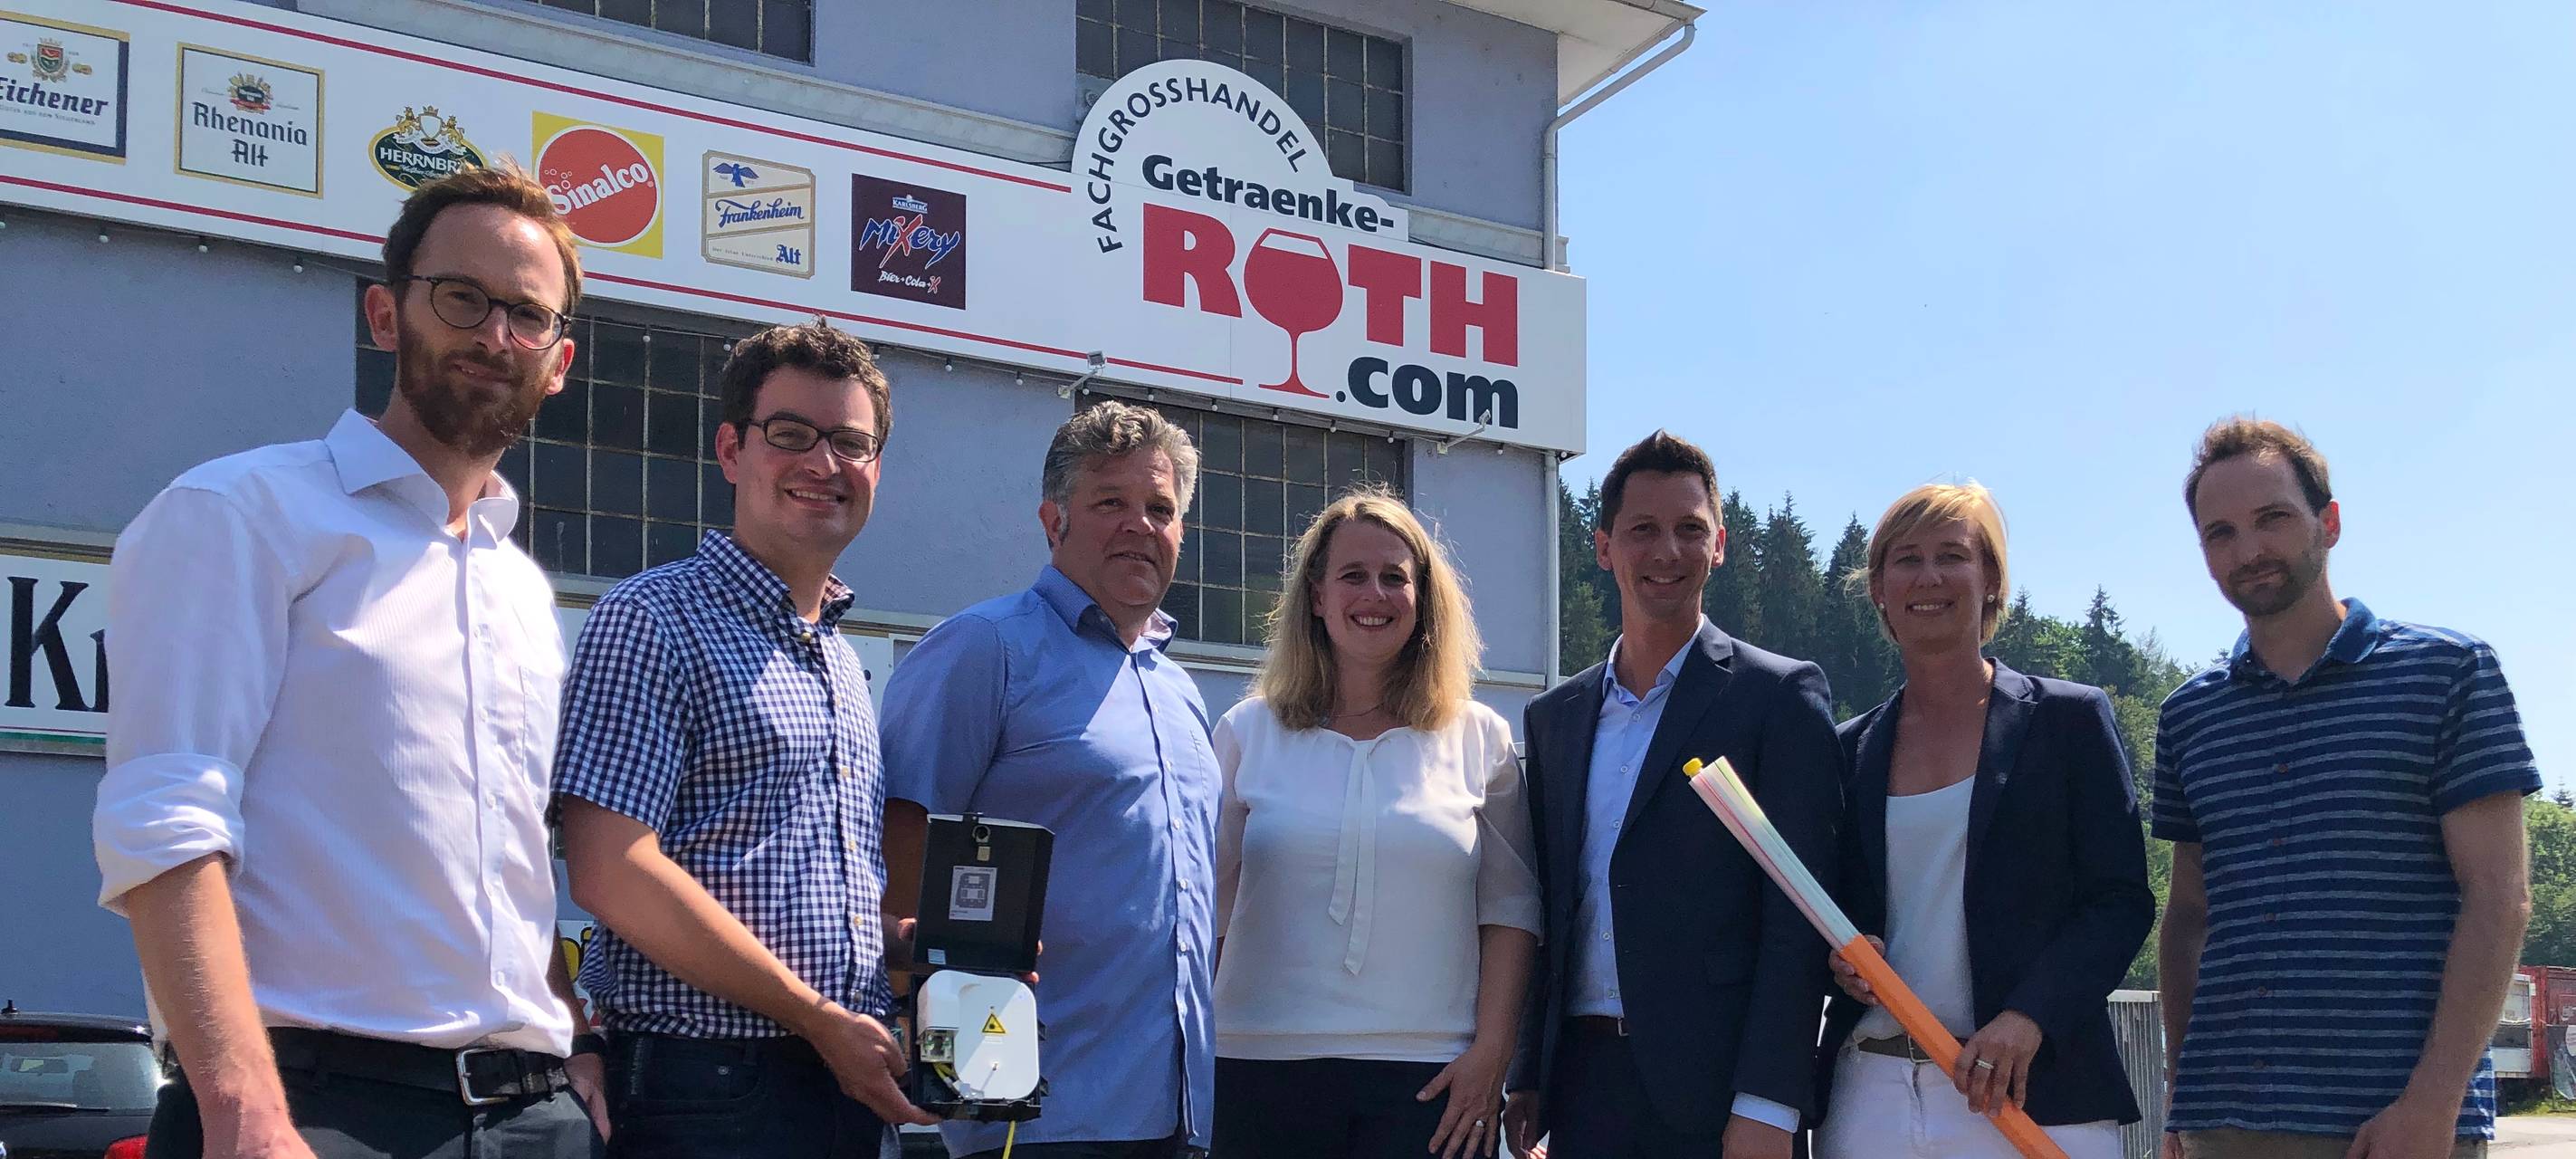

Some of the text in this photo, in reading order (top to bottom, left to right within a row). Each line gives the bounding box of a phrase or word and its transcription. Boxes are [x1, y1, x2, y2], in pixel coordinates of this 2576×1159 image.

[0, 76, 109, 116] Eichener
[192, 101, 308, 146] Rhenania
[231, 139, 269, 167] Alt
[380, 147, 461, 174] HERRNBR
[1087, 77, 1307, 254] FACHGROSSHANDEL
[545, 163, 649, 216] Sinalco
[1141, 154, 1395, 233] Getraenke-
[715, 197, 805, 228] Frankenheim
[776, 244, 801, 265] Alt
[1143, 202, 1519, 398] ROTH
[1336, 357, 1519, 429] .com
